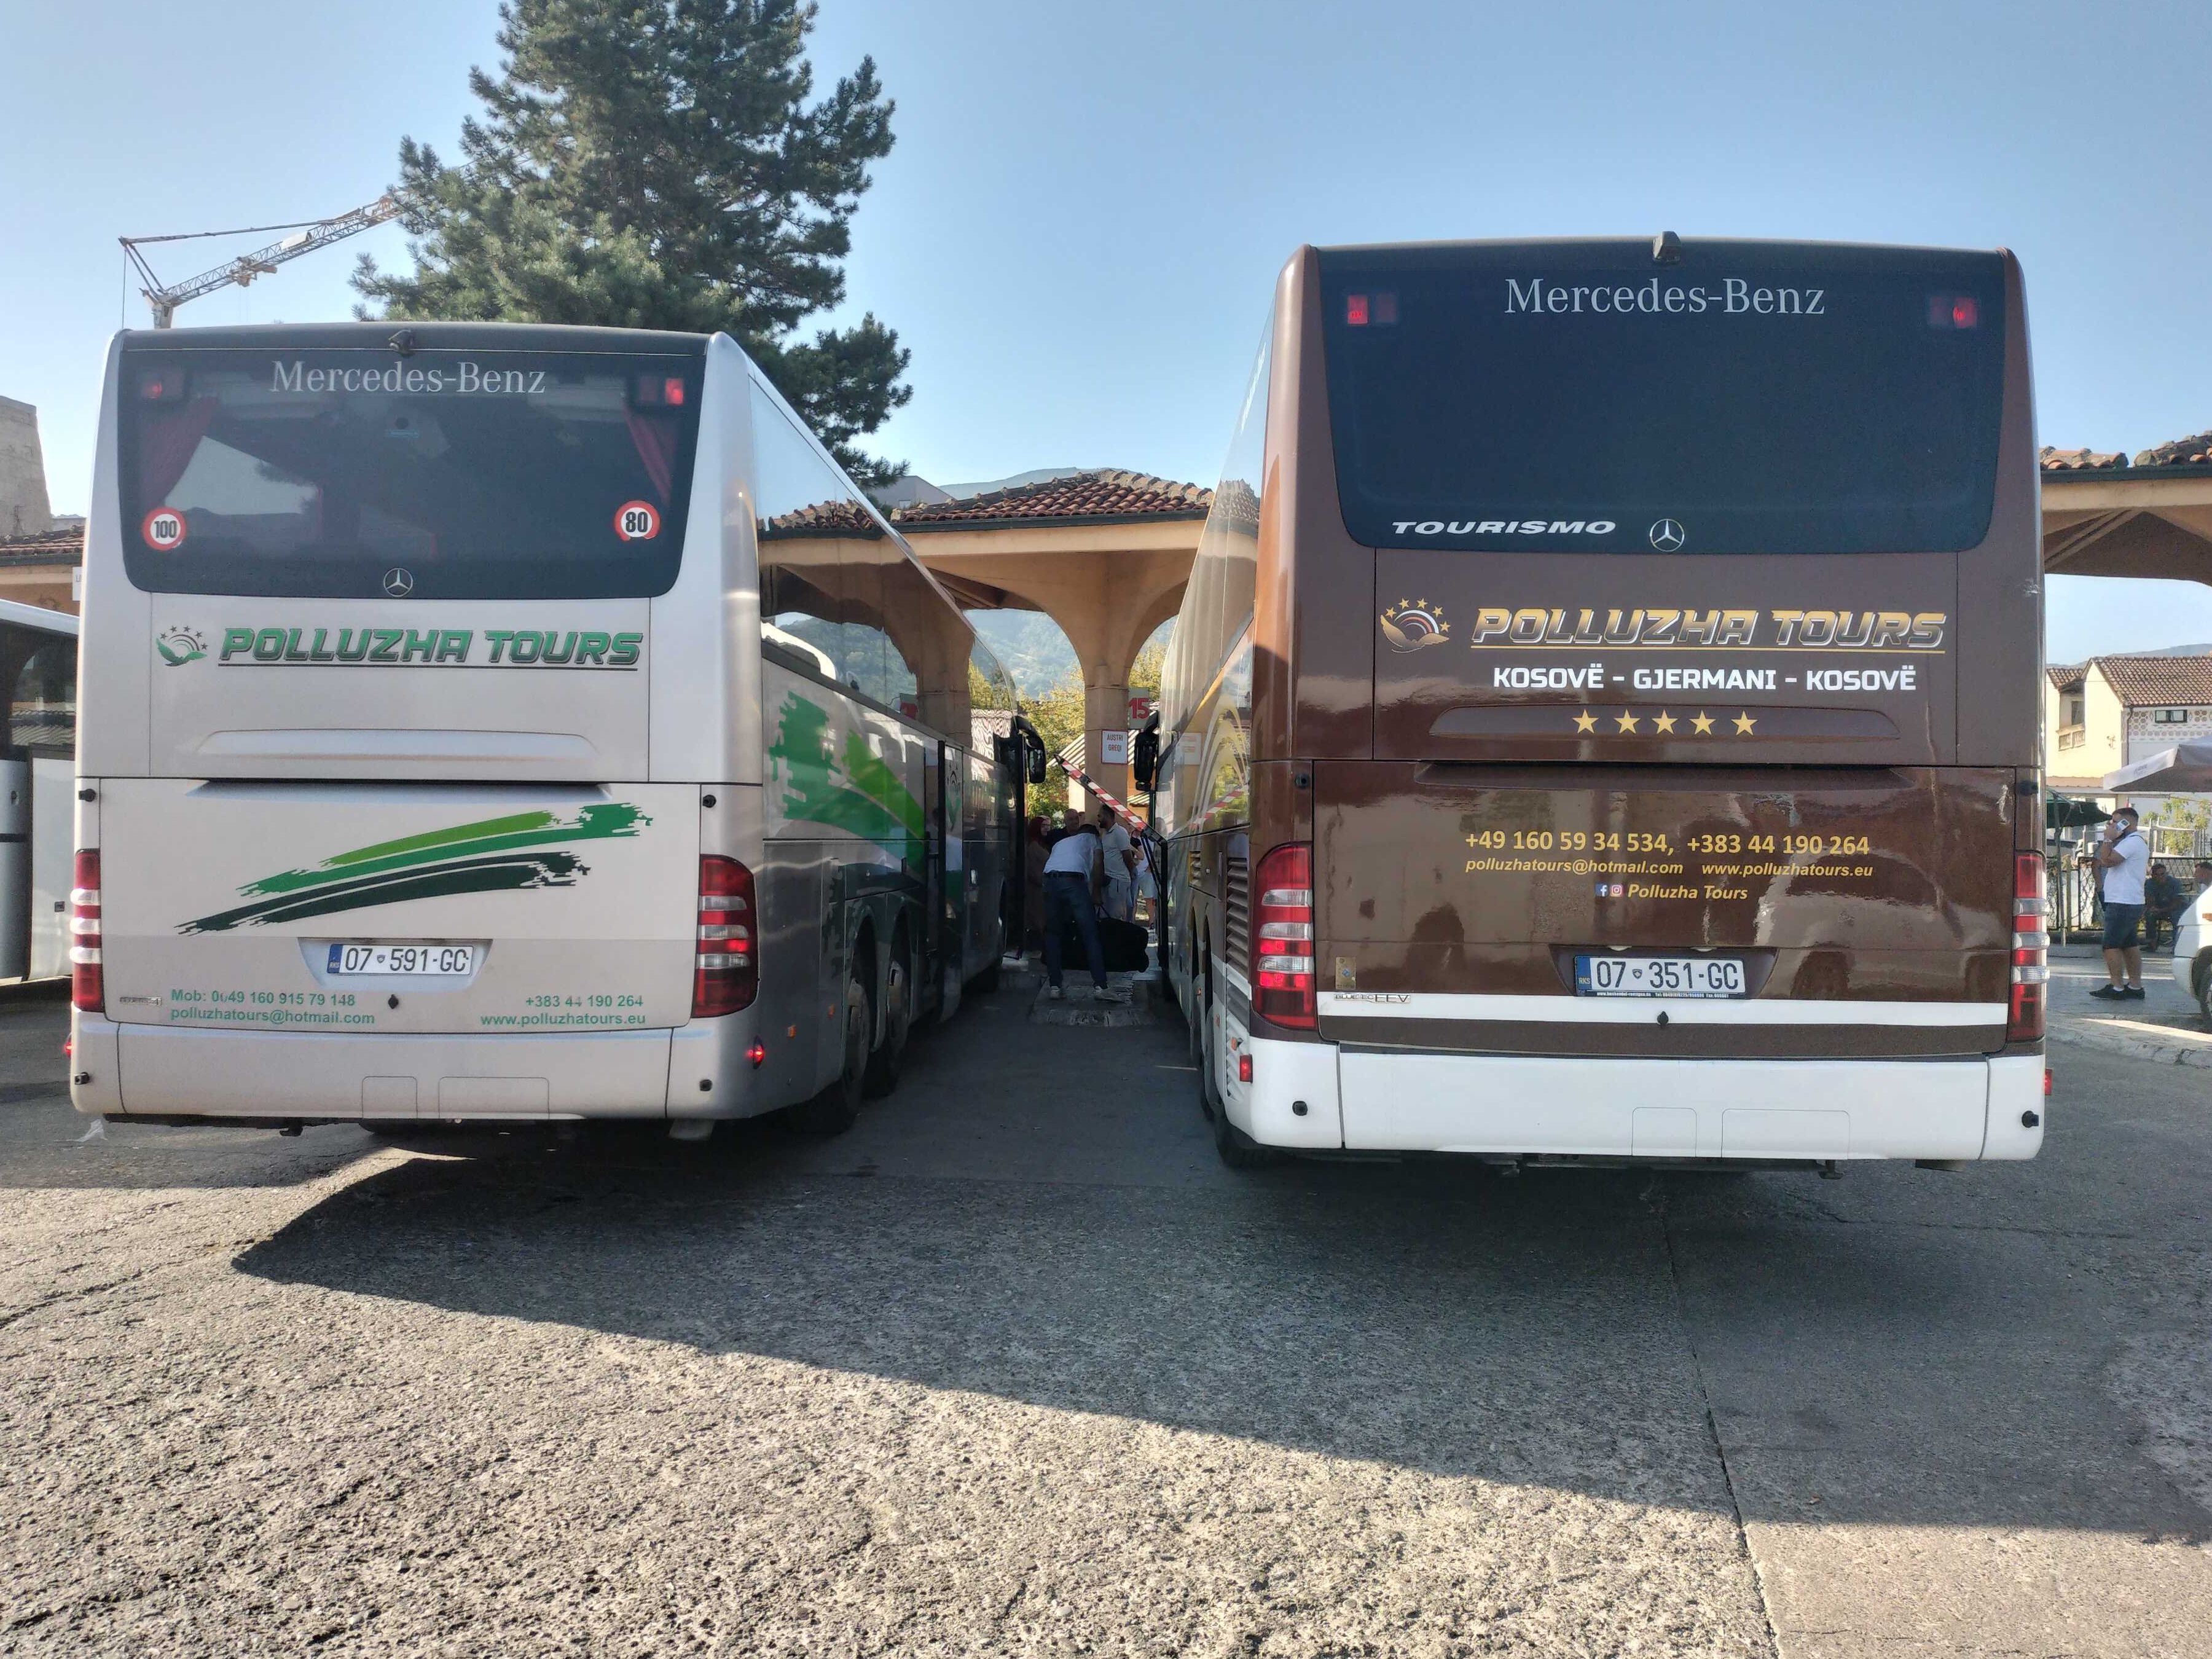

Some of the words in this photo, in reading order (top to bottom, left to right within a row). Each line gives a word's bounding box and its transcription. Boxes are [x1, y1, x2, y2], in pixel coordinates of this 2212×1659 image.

[1504, 277, 1826, 315] Mercedes-Benz
[269, 360, 546, 394] Mercedes-Benz
[154, 520, 178, 539] 100
[625, 511, 648, 533] 80
[1392, 520, 1617, 535] TOURISMO
[1471, 607, 1759, 645] POLLUZHA
[1771, 610, 1947, 648] TOURS
[219, 628, 474, 662] POLLUZHA
[484, 630, 644, 665] TOURS
[1494, 662, 1604, 689] KOSOVË
[1633, 668, 1776, 690] GJERMANI
[1806, 664, 1916, 691] KOSOVË
[1127, 697, 1149, 720] 15
[1465, 830, 1506, 849] +49
[1513, 831, 1553, 850] 160
[1559, 832, 1586, 851] 59
[1593, 833, 1620, 852] 34
[1626, 833, 1674, 856] 534,
[1687, 834, 1741, 854] +383
[1747, 835, 1776, 854] 44
[1783, 836, 1823, 855] 190
[1829, 836, 1870, 855] 264
[1465, 858, 1684, 876] polluzhatours@hotmail.com
[1701, 862, 1873, 877] www.polluzhatours.eu
[1628, 883, 1698, 899] Polluzha
[1703, 885, 1748, 900] Tours
[345, 947, 374, 971] 07
[1596, 960, 1626, 988] 07
[171, 989, 206, 1002] Mob:
[251, 991, 274, 1005] 160
[279, 992, 304, 1005] 915
[310, 993, 325, 1006] 79
[331, 994, 355, 1006] 148
[526, 995, 560, 1007] +383
[565, 995, 582, 1008] 44
[588, 995, 612, 1008] 190
[618, 995, 643, 1007] 264
[170, 1006, 375, 1025] polluzhatours@hotmail.com
[480, 1013, 646, 1027] www.polluzhatours.eu
